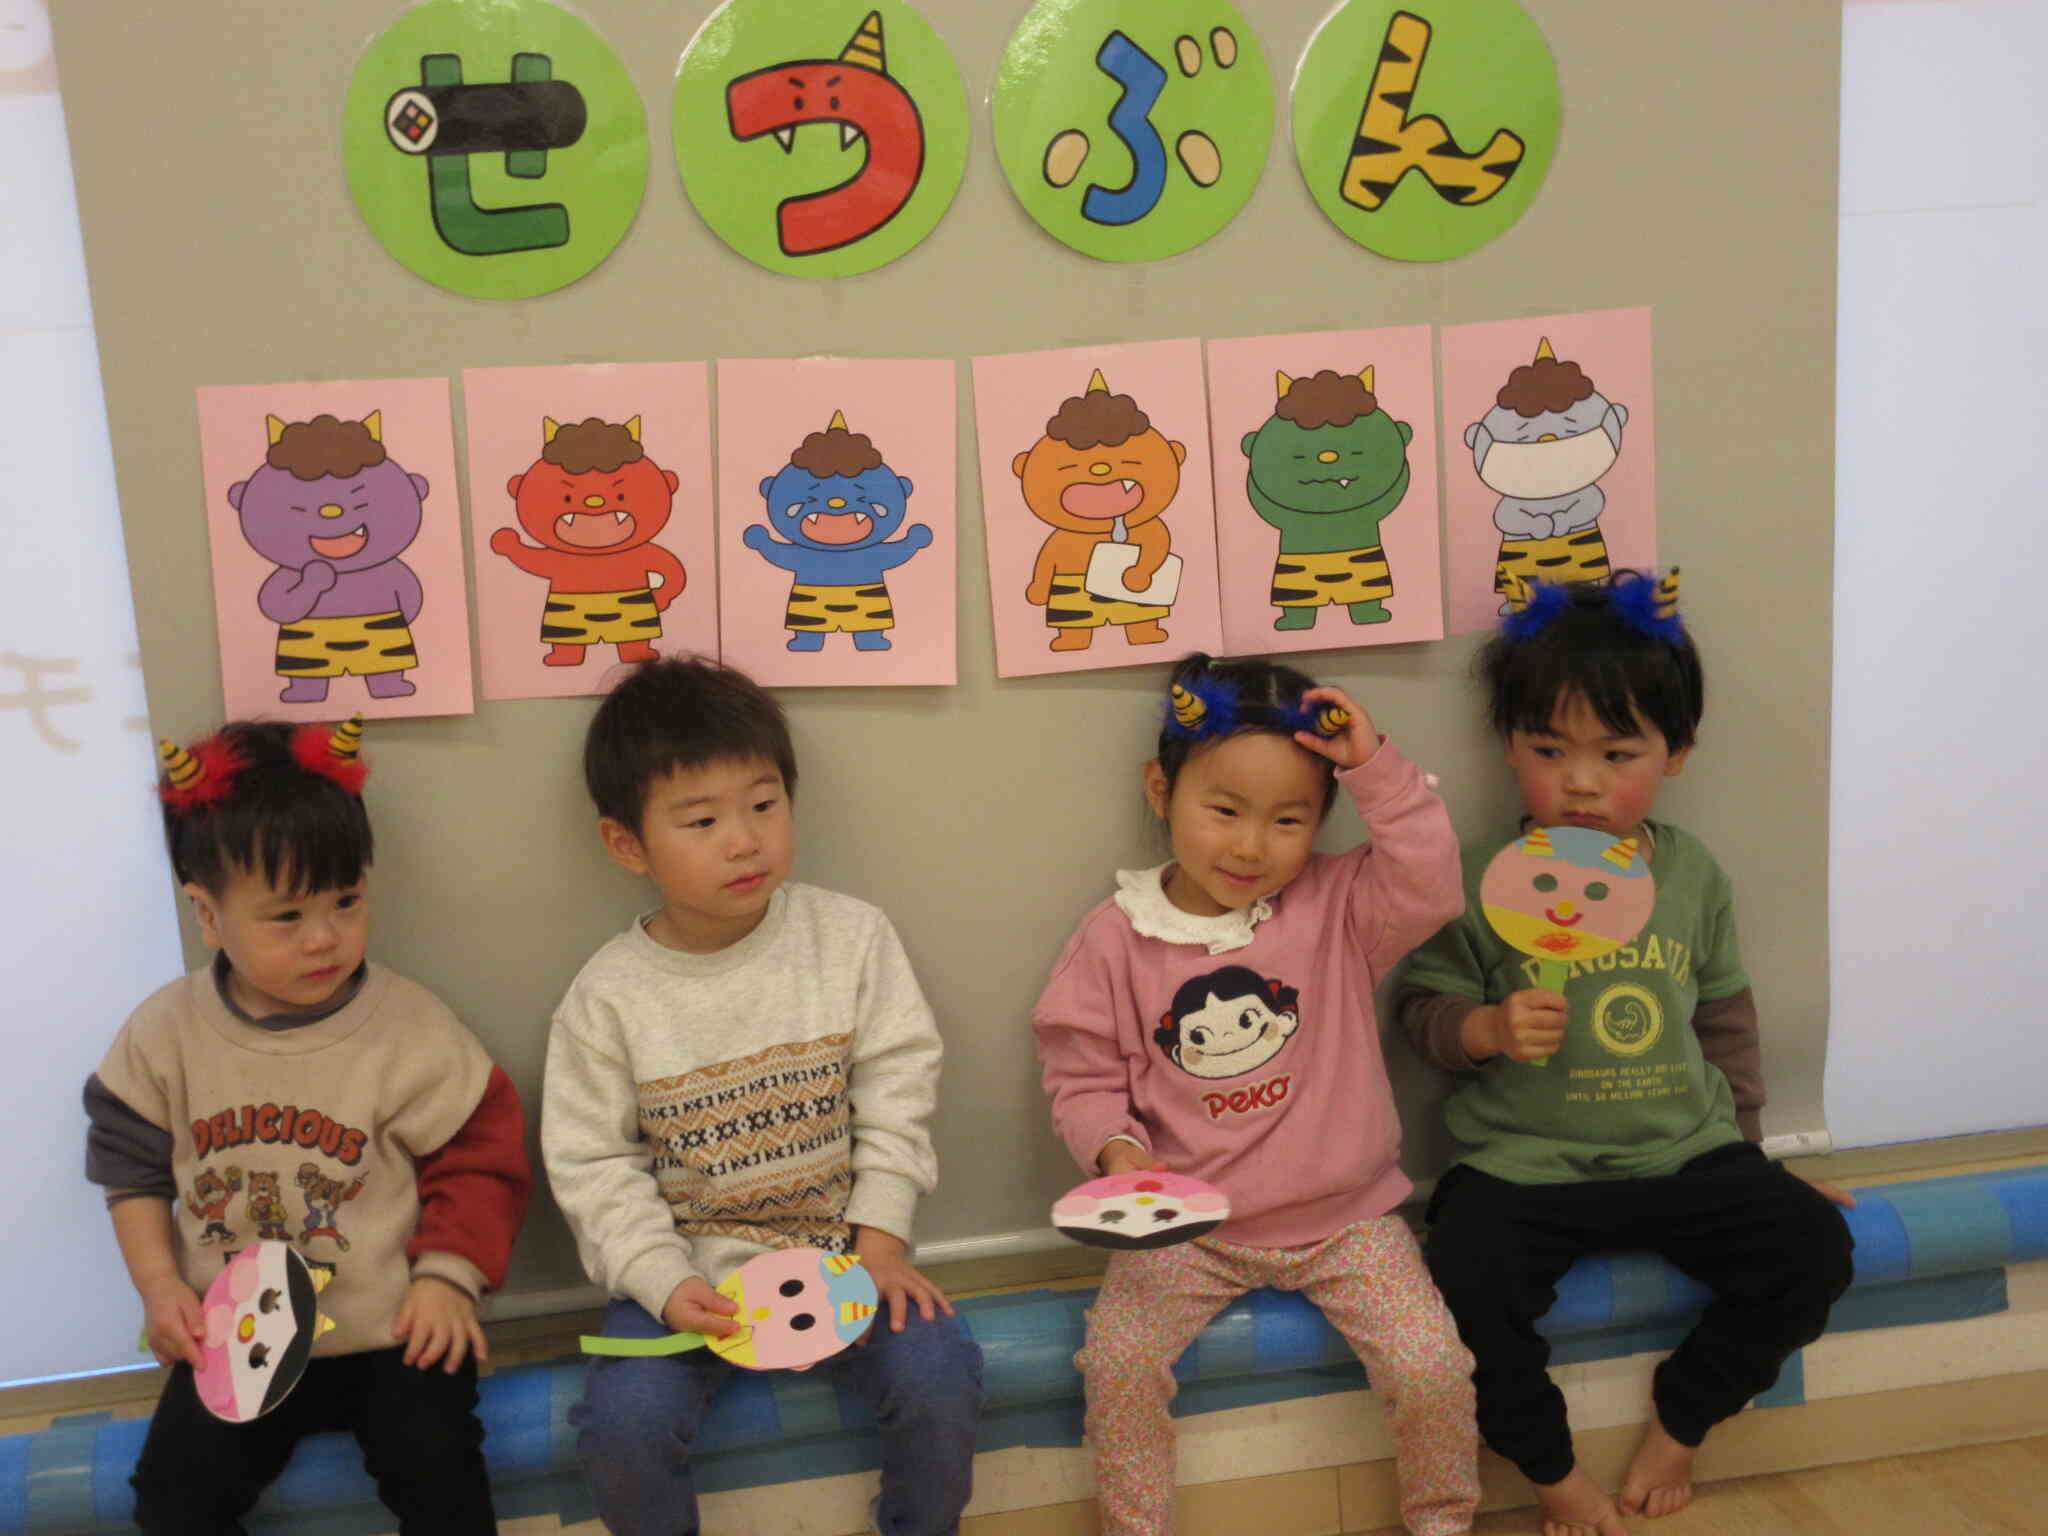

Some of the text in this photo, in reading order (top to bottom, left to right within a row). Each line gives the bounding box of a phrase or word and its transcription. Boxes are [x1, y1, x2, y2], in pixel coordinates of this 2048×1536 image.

[384, 9, 1525, 257] せつぶん
[192, 1102, 368, 1166] DELICIOUS
